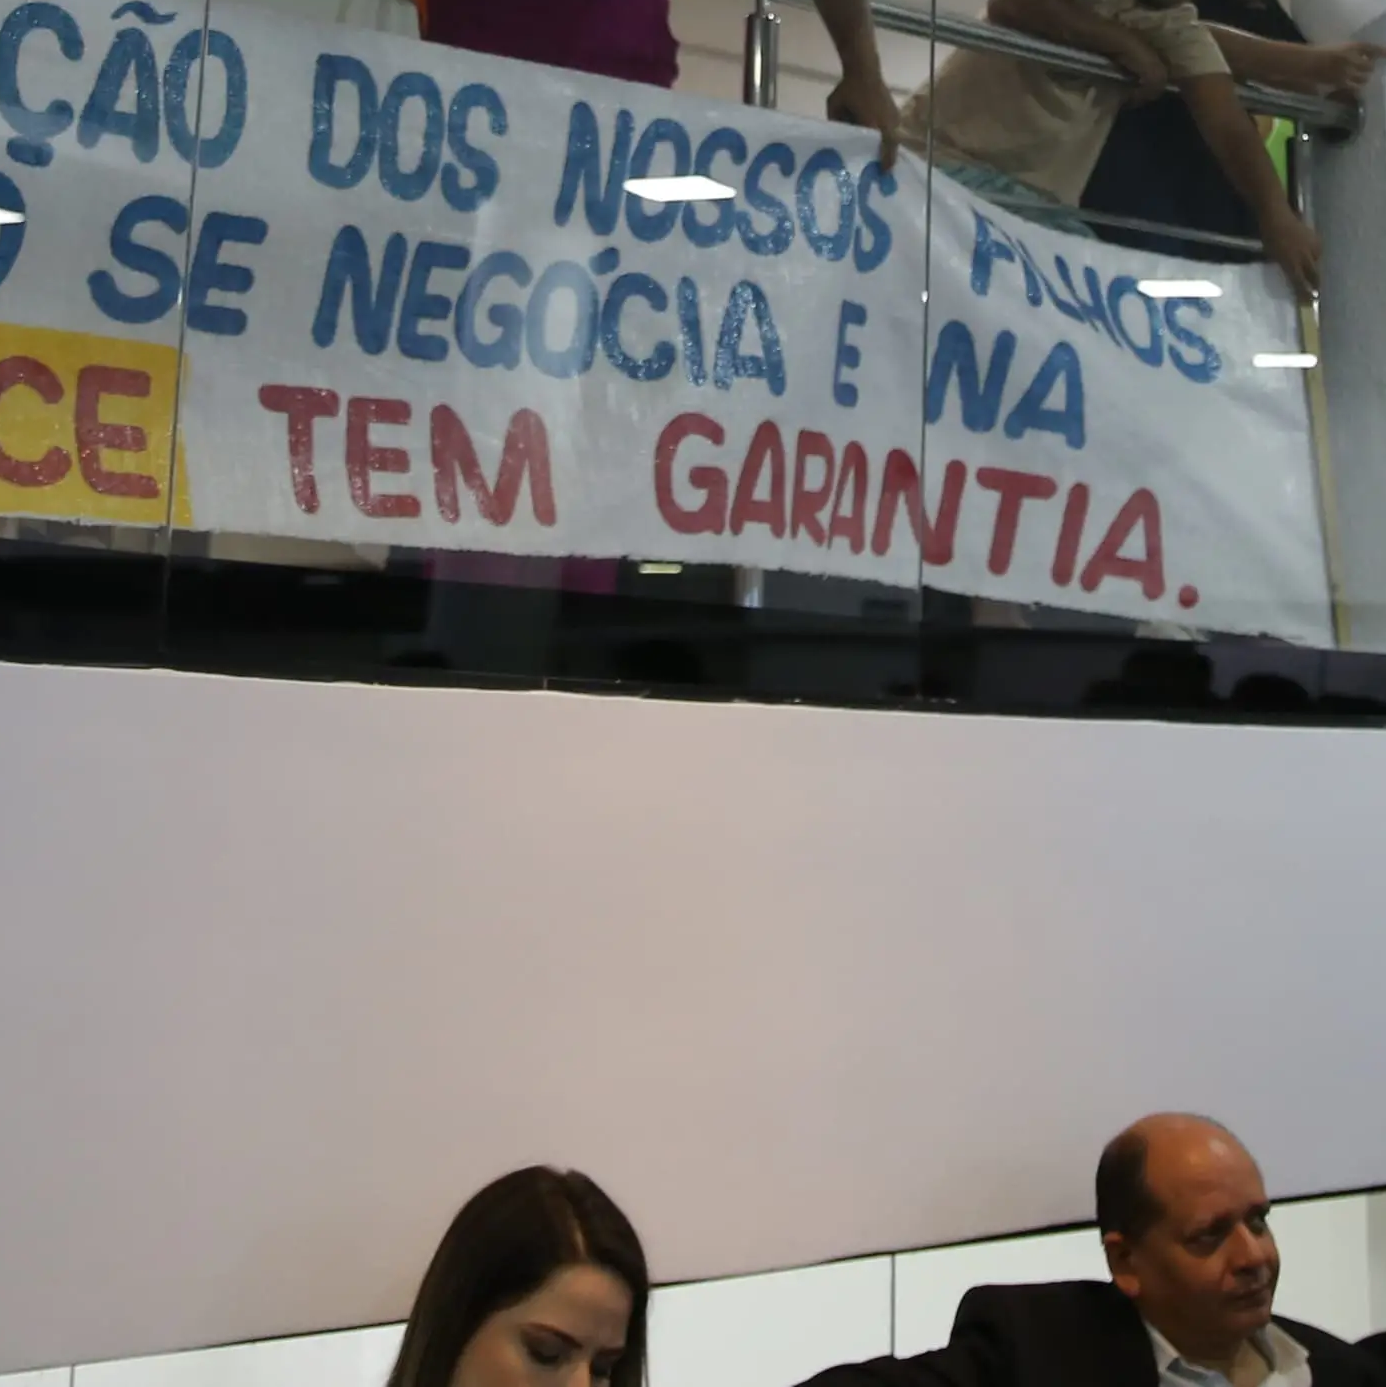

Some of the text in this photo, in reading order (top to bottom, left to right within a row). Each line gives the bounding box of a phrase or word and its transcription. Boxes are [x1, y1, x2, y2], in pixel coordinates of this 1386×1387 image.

[307, 52, 507, 213] DOS
[553, 100, 898, 273] NOSSOS
[87, 195, 269, 336] SE
[310, 224, 787, 397] NEGÓCIA
[834, 298, 868, 408] E
[925, 319, 1088, 450] NA
[257, 384, 557, 529] TEM
[653, 410, 1201, 610] GARANTIA.
